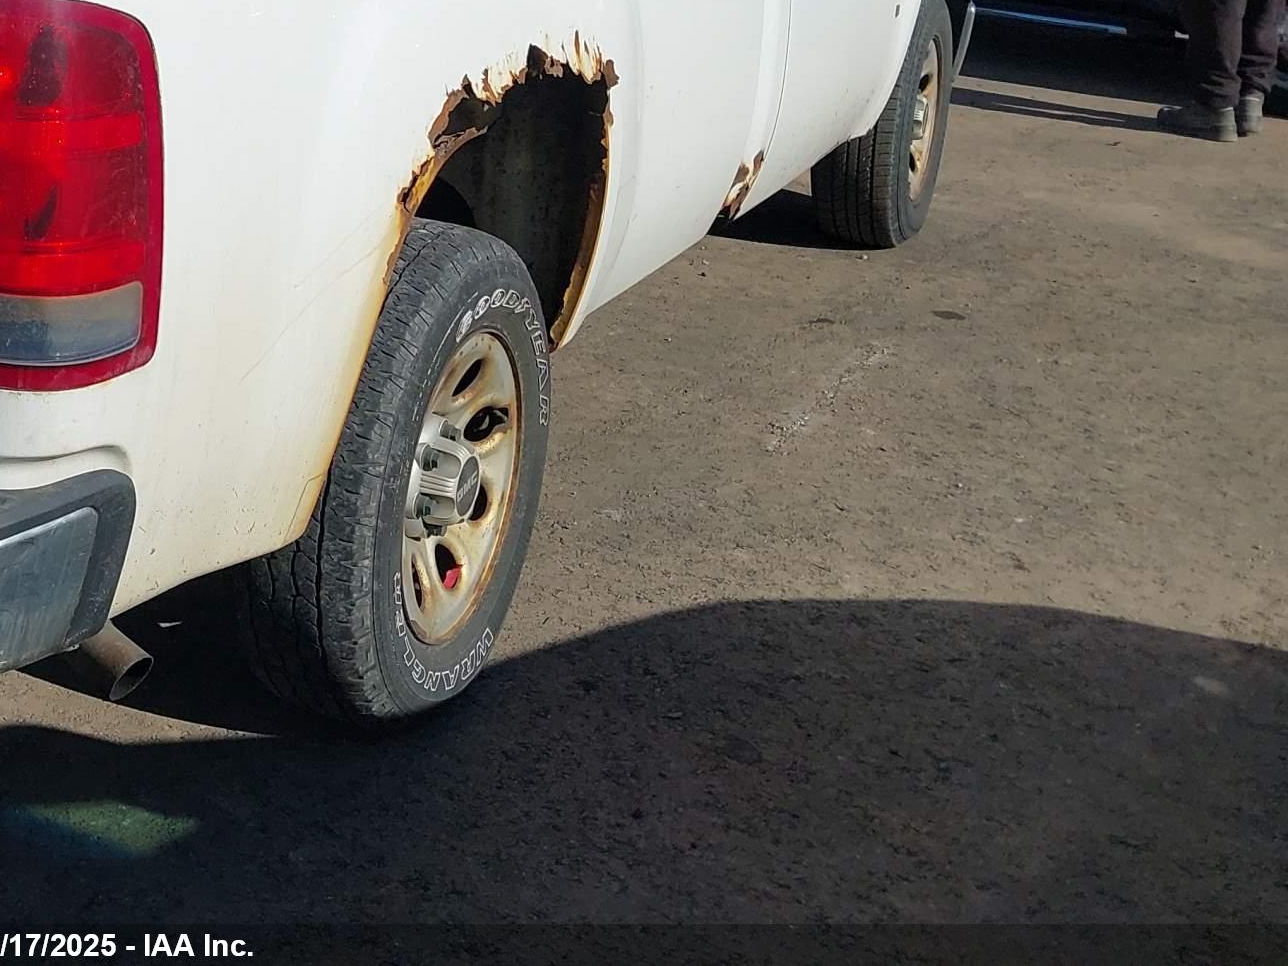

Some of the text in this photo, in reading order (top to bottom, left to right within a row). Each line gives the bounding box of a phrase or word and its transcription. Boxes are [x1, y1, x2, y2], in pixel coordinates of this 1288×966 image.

[455, 288, 550, 426] GOODYEAR
[456, 471, 479, 503] GMC
[393, 572, 494, 690] WRANGLER
